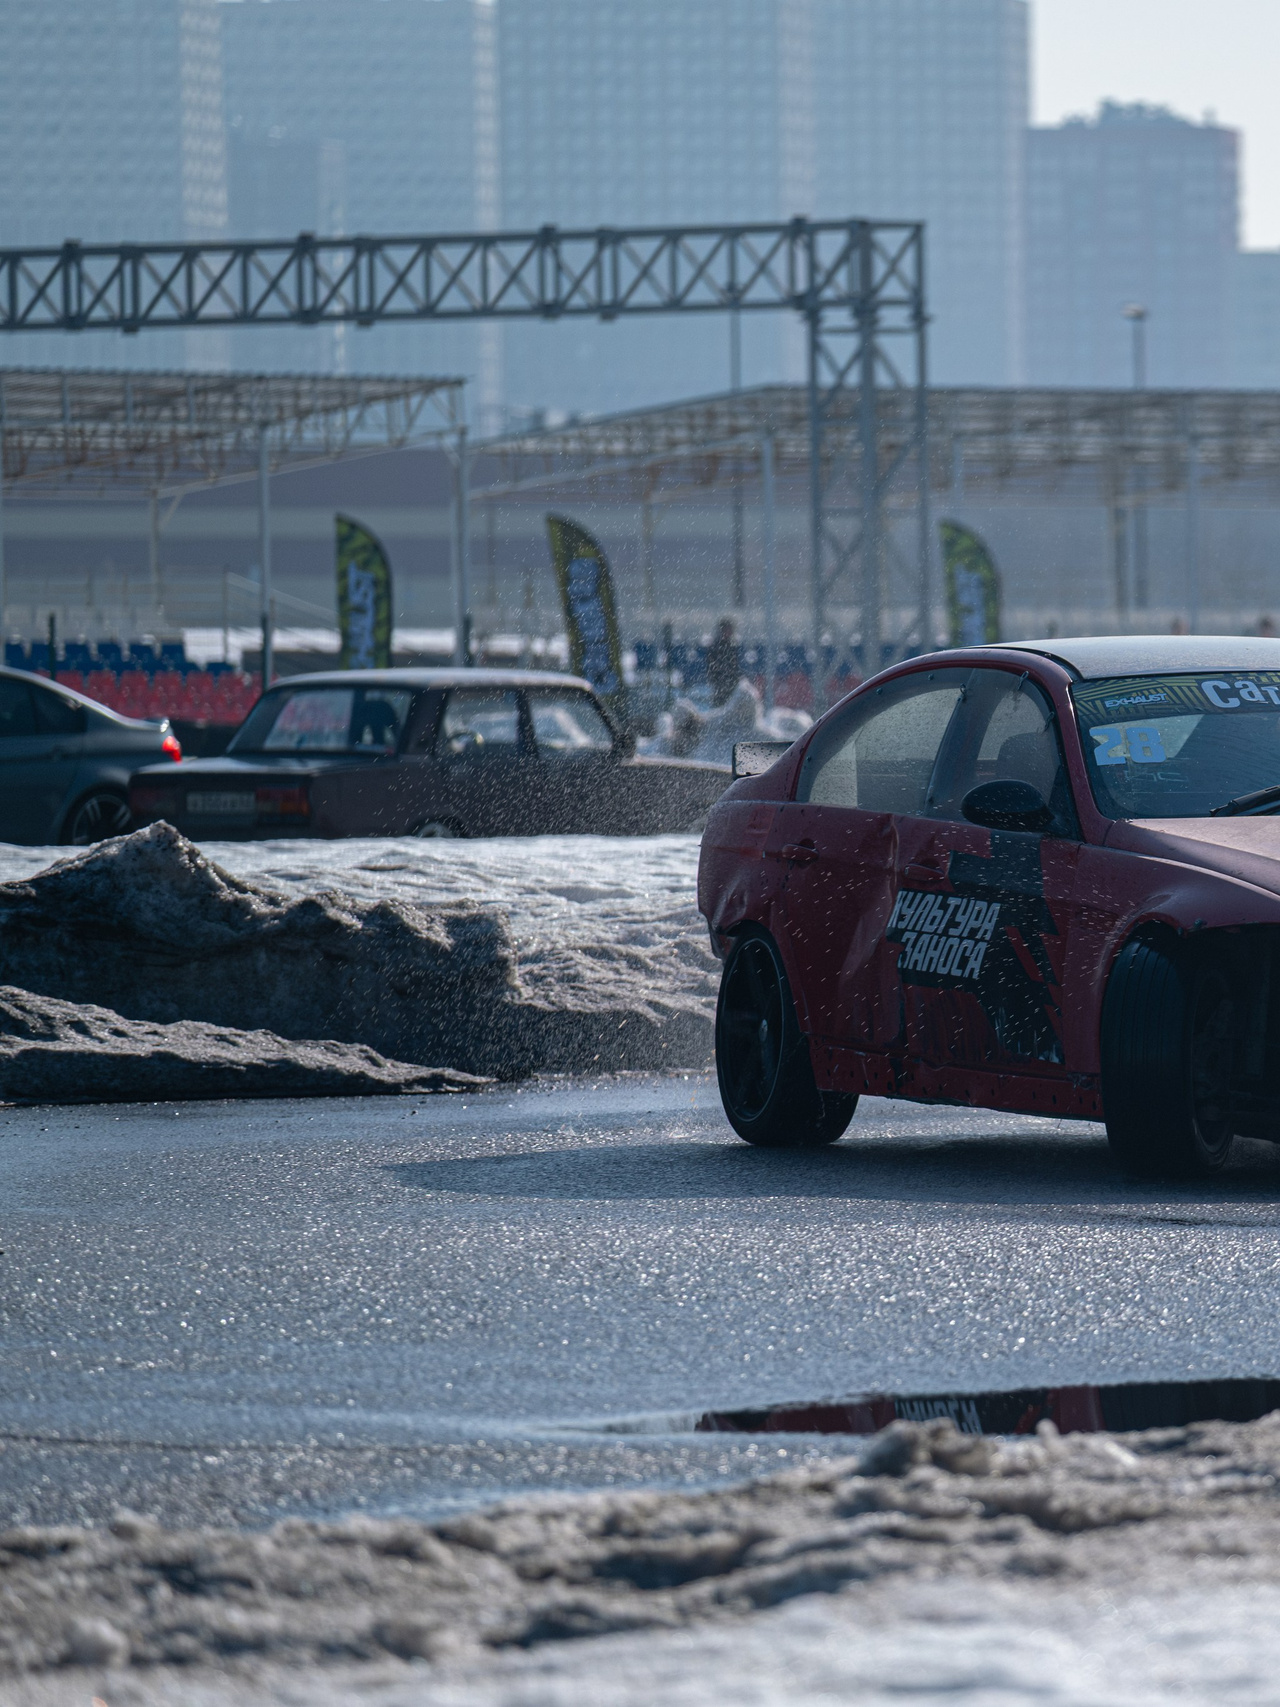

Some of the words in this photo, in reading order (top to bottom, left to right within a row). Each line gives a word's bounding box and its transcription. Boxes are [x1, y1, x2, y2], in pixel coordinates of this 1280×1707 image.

[1105, 692, 1167, 708] EXHAUST
[1089, 727, 1167, 766] 28
[888, 890, 1001, 940] КУЛЬТУРА
[898, 931, 988, 979] ЗАНОСА
